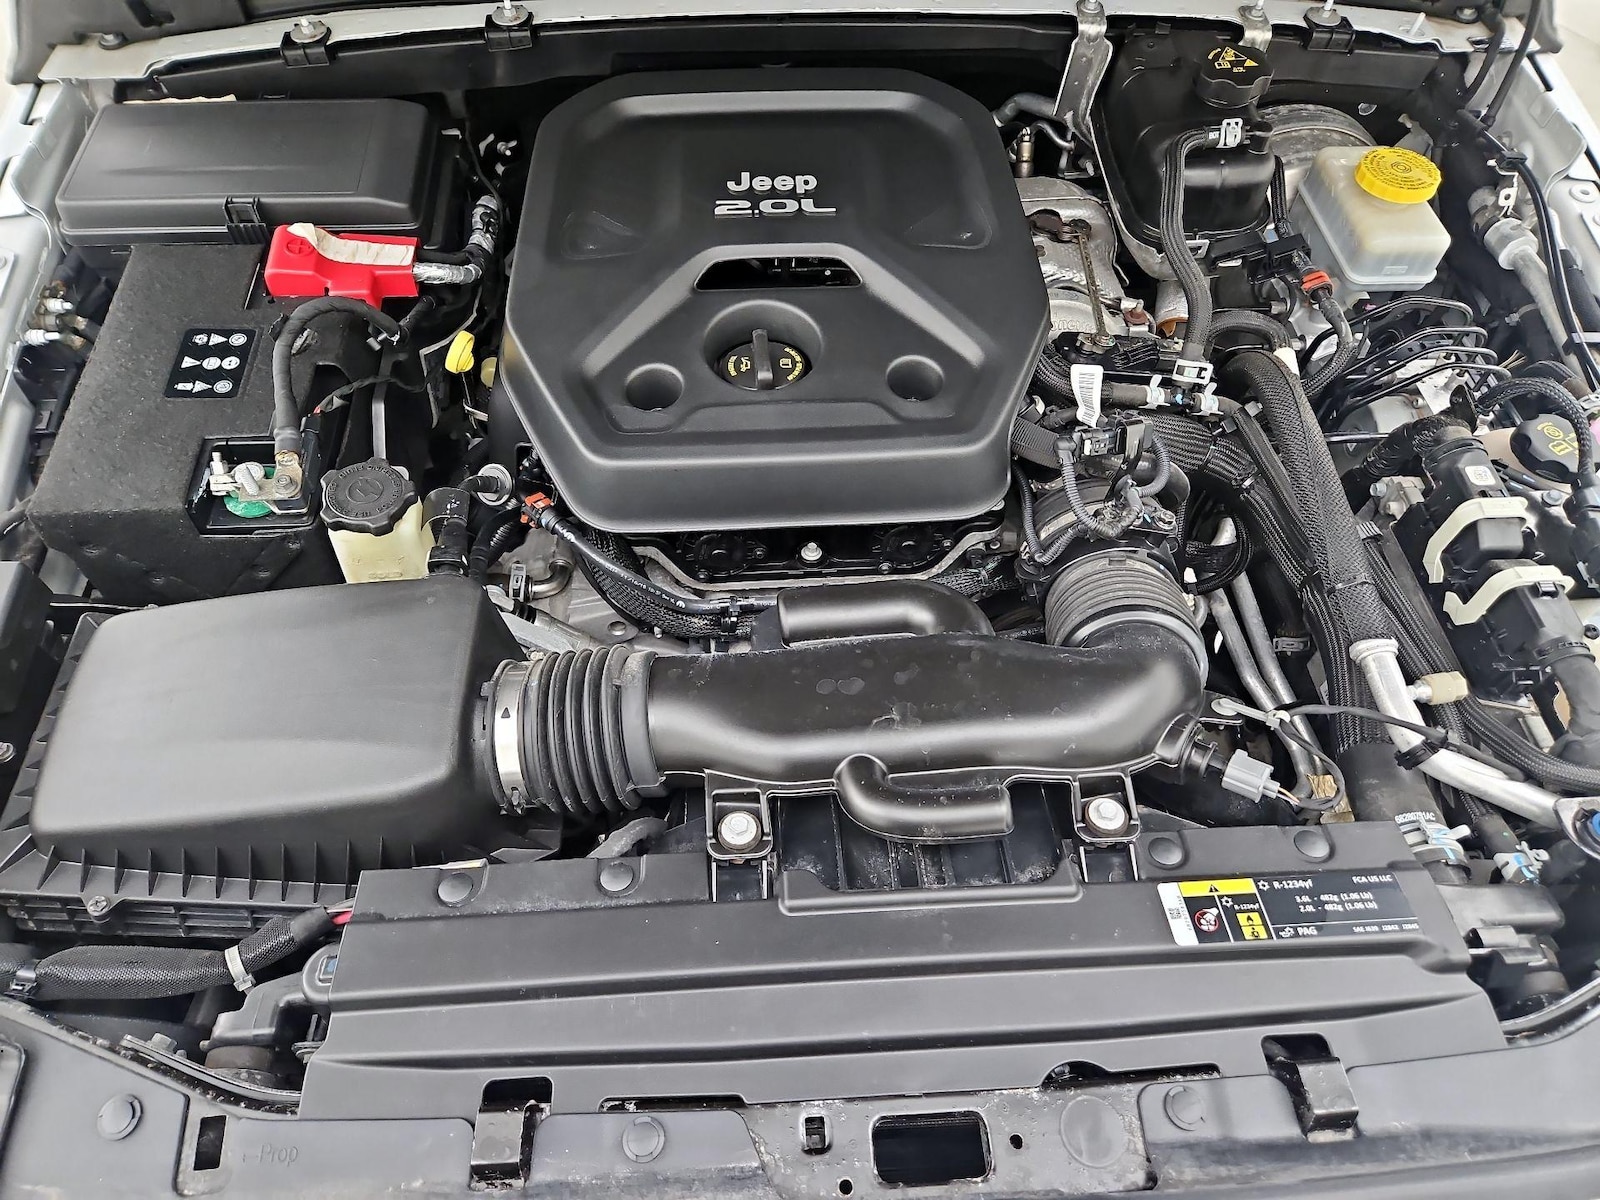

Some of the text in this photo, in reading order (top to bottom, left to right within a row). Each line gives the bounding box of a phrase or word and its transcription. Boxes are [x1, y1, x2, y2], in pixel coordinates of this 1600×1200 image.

[726, 171, 818, 195] Jeep
[714, 198, 837, 217] 2.0L
[1272, 878, 1314, 890] R-1234yf
[1351, 875, 1367, 884] FCA
[1379, 874, 1393, 882] LLC
[1299, 904, 1316, 912] 2.0L
[1296, 926, 1318, 936] PAG
[259, 1142, 299, 1168] Prop
